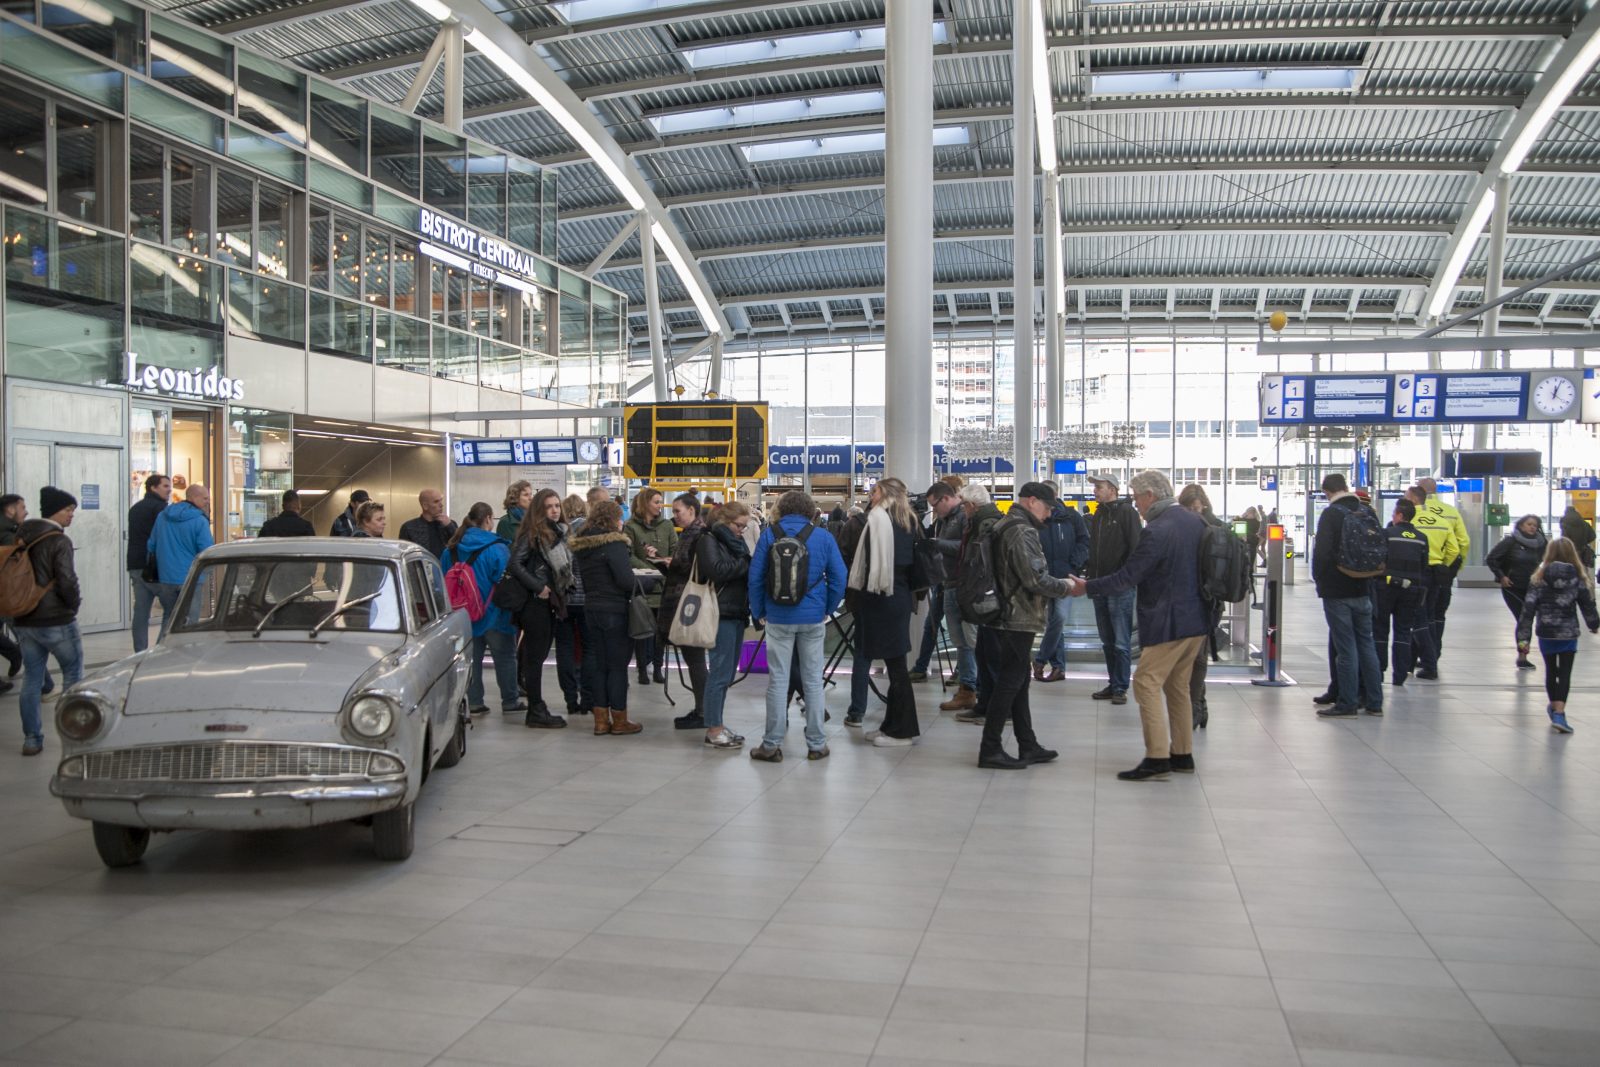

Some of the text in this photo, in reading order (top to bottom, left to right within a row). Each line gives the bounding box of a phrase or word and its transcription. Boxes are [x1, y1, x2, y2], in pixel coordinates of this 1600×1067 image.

[420, 208, 537, 278] BISTROT CENTRAAL
[473, 262, 494, 280] UTRECHT
[124, 352, 245, 401] Leonidas
[1292, 386, 1297, 396] 1
[1422, 384, 1430, 395] 3
[1290, 407, 1297, 417] 2
[613, 448, 621, 465] 1
[668, 456, 718, 464] TEKSTKAR.nl
[769, 451, 840, 465] Centrum
